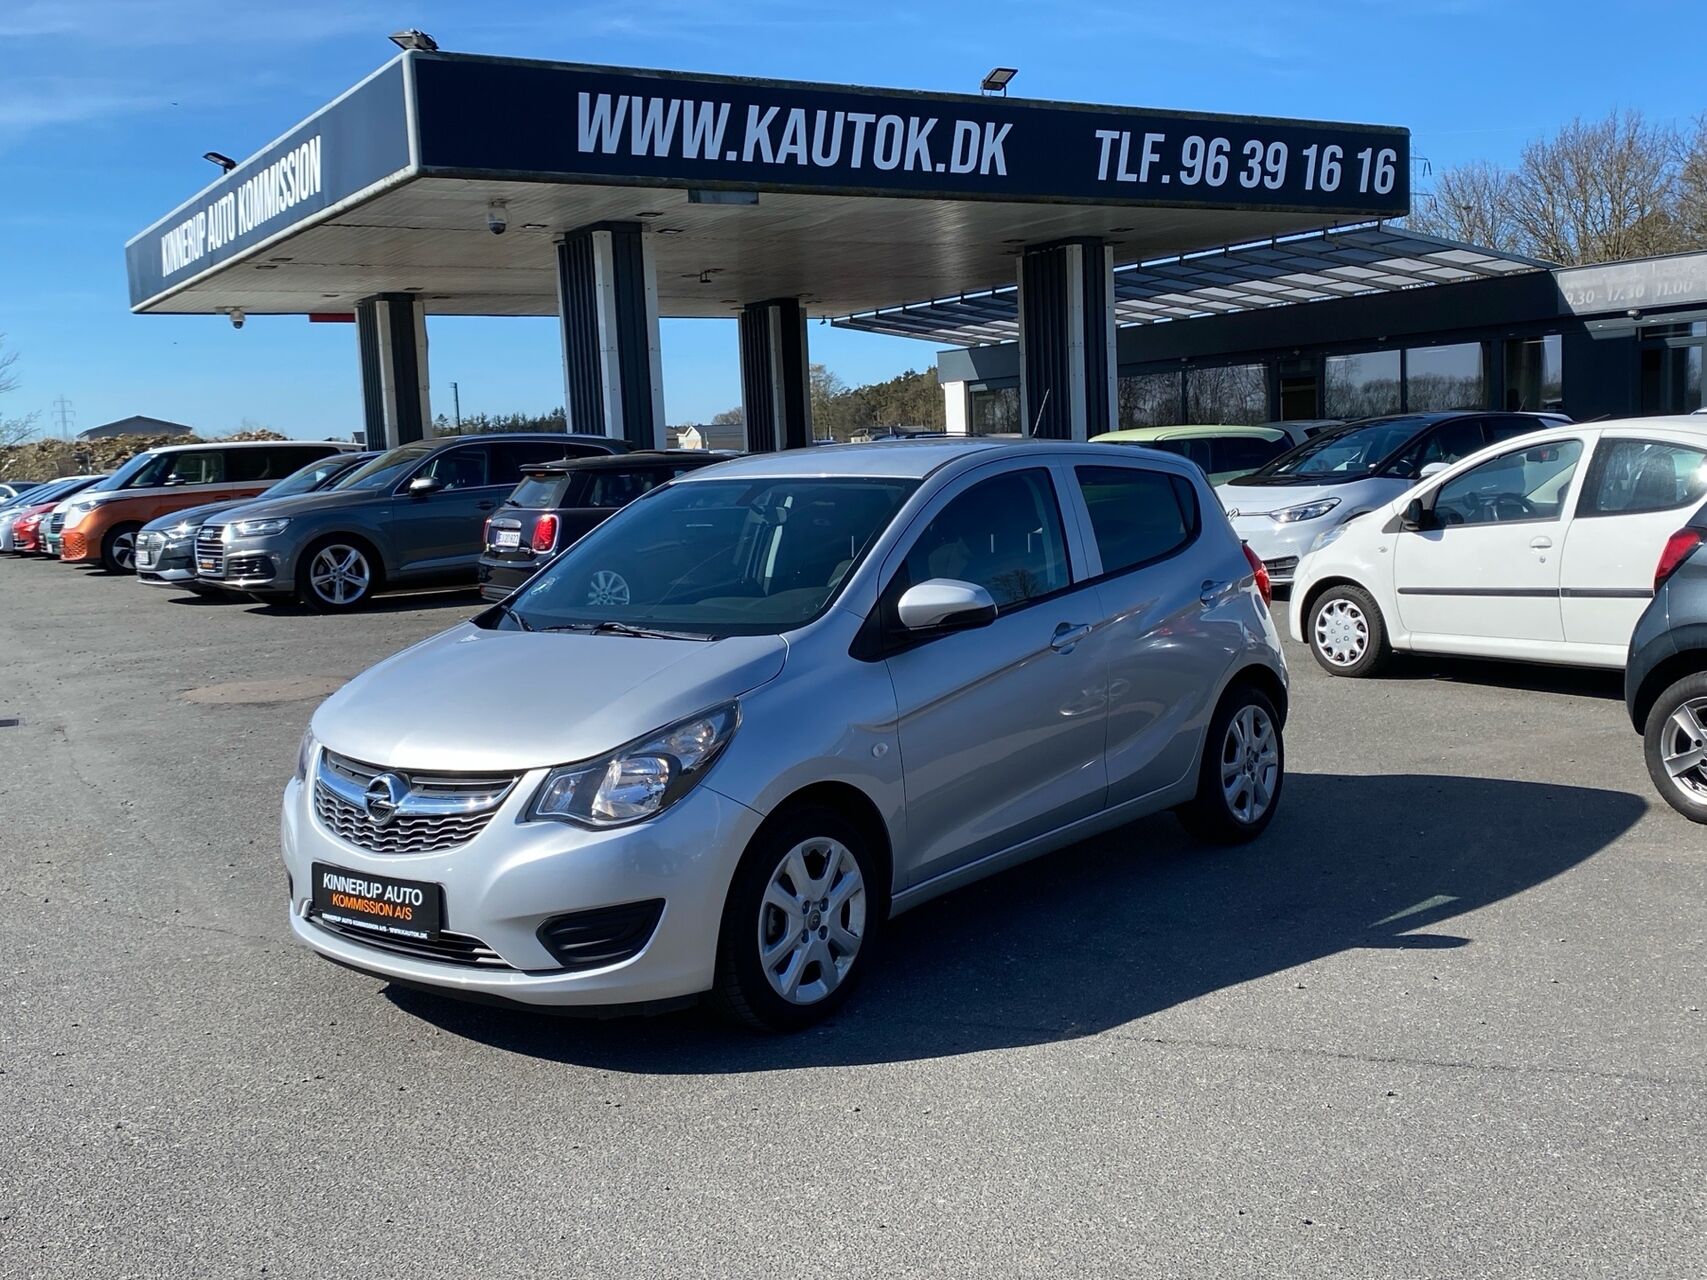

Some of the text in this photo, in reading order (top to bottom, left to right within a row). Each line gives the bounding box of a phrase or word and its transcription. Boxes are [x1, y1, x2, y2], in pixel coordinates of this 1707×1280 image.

[578, 92, 1013, 176] WWW.KAUTOK.DK
[1095, 129, 1397, 194] TLF. 96 39 16 16
[161, 135, 321, 277] KINNERUP AUTO KOMMISSION
[323, 872, 423, 906] KINNERUP AUTO
[332, 893, 413, 921] KOMMISSION A/S
